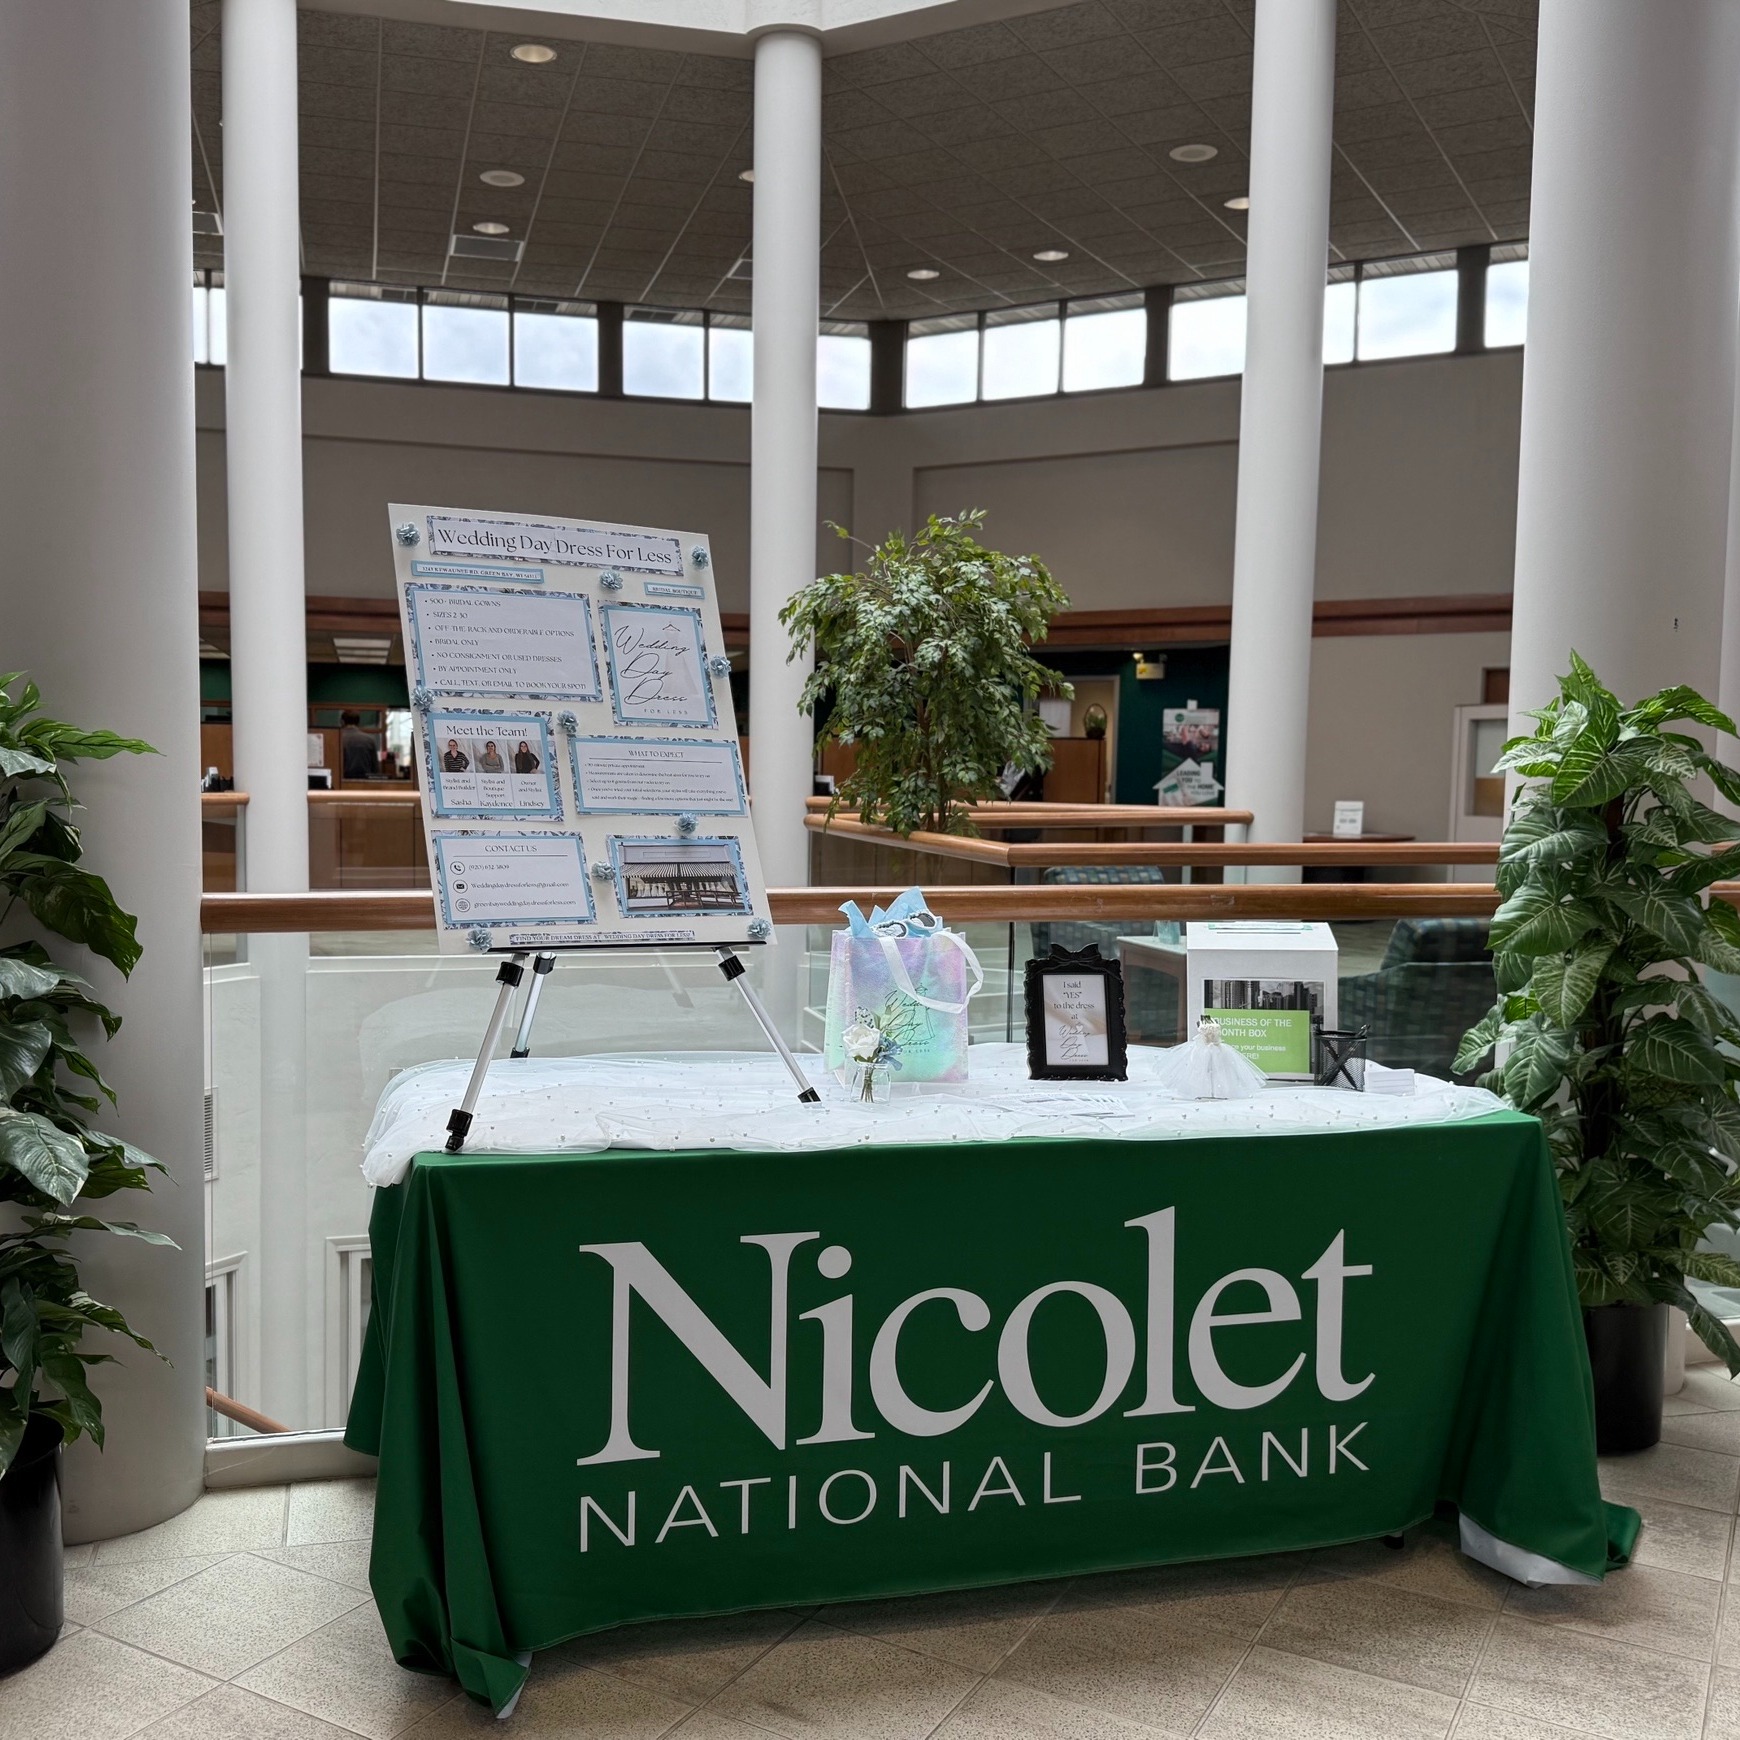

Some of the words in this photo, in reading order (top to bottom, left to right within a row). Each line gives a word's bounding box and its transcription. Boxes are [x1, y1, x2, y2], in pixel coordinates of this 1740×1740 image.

[438, 529, 516, 552] Wedding
[520, 535, 553, 554] Day
[556, 539, 602, 557] Dress
[606, 544, 633, 559] For
[638, 548, 672, 564] Less
[504, 628, 543, 636] ORDERABLE
[614, 625, 690, 656] Wedding
[449, 652, 500, 660] CONSIGNMENT
[620, 651, 672, 680] Day
[624, 677, 687, 705] Dress
[447, 725, 473, 735] Meet
[476, 725, 494, 736] the
[496, 726, 528, 737] Team!
[1260, 1018, 1272, 1026] OF
[1275, 1019, 1292, 1027] THE
[1059, 1025, 1090, 1038] Wedding
[1219, 1028, 1246, 1036] ONTH
[1249, 1029, 1267, 1037] BOX
[1060, 1036, 1082, 1049] Day
[1240, 1045, 1255, 1053] your
[1060, 1048, 1088, 1060] Dress
[576, 1205, 1375, 1466] Nicolet
[578, 1450, 1082, 1553] NATIONAL
[1135, 1420, 1372, 1494] BANK
